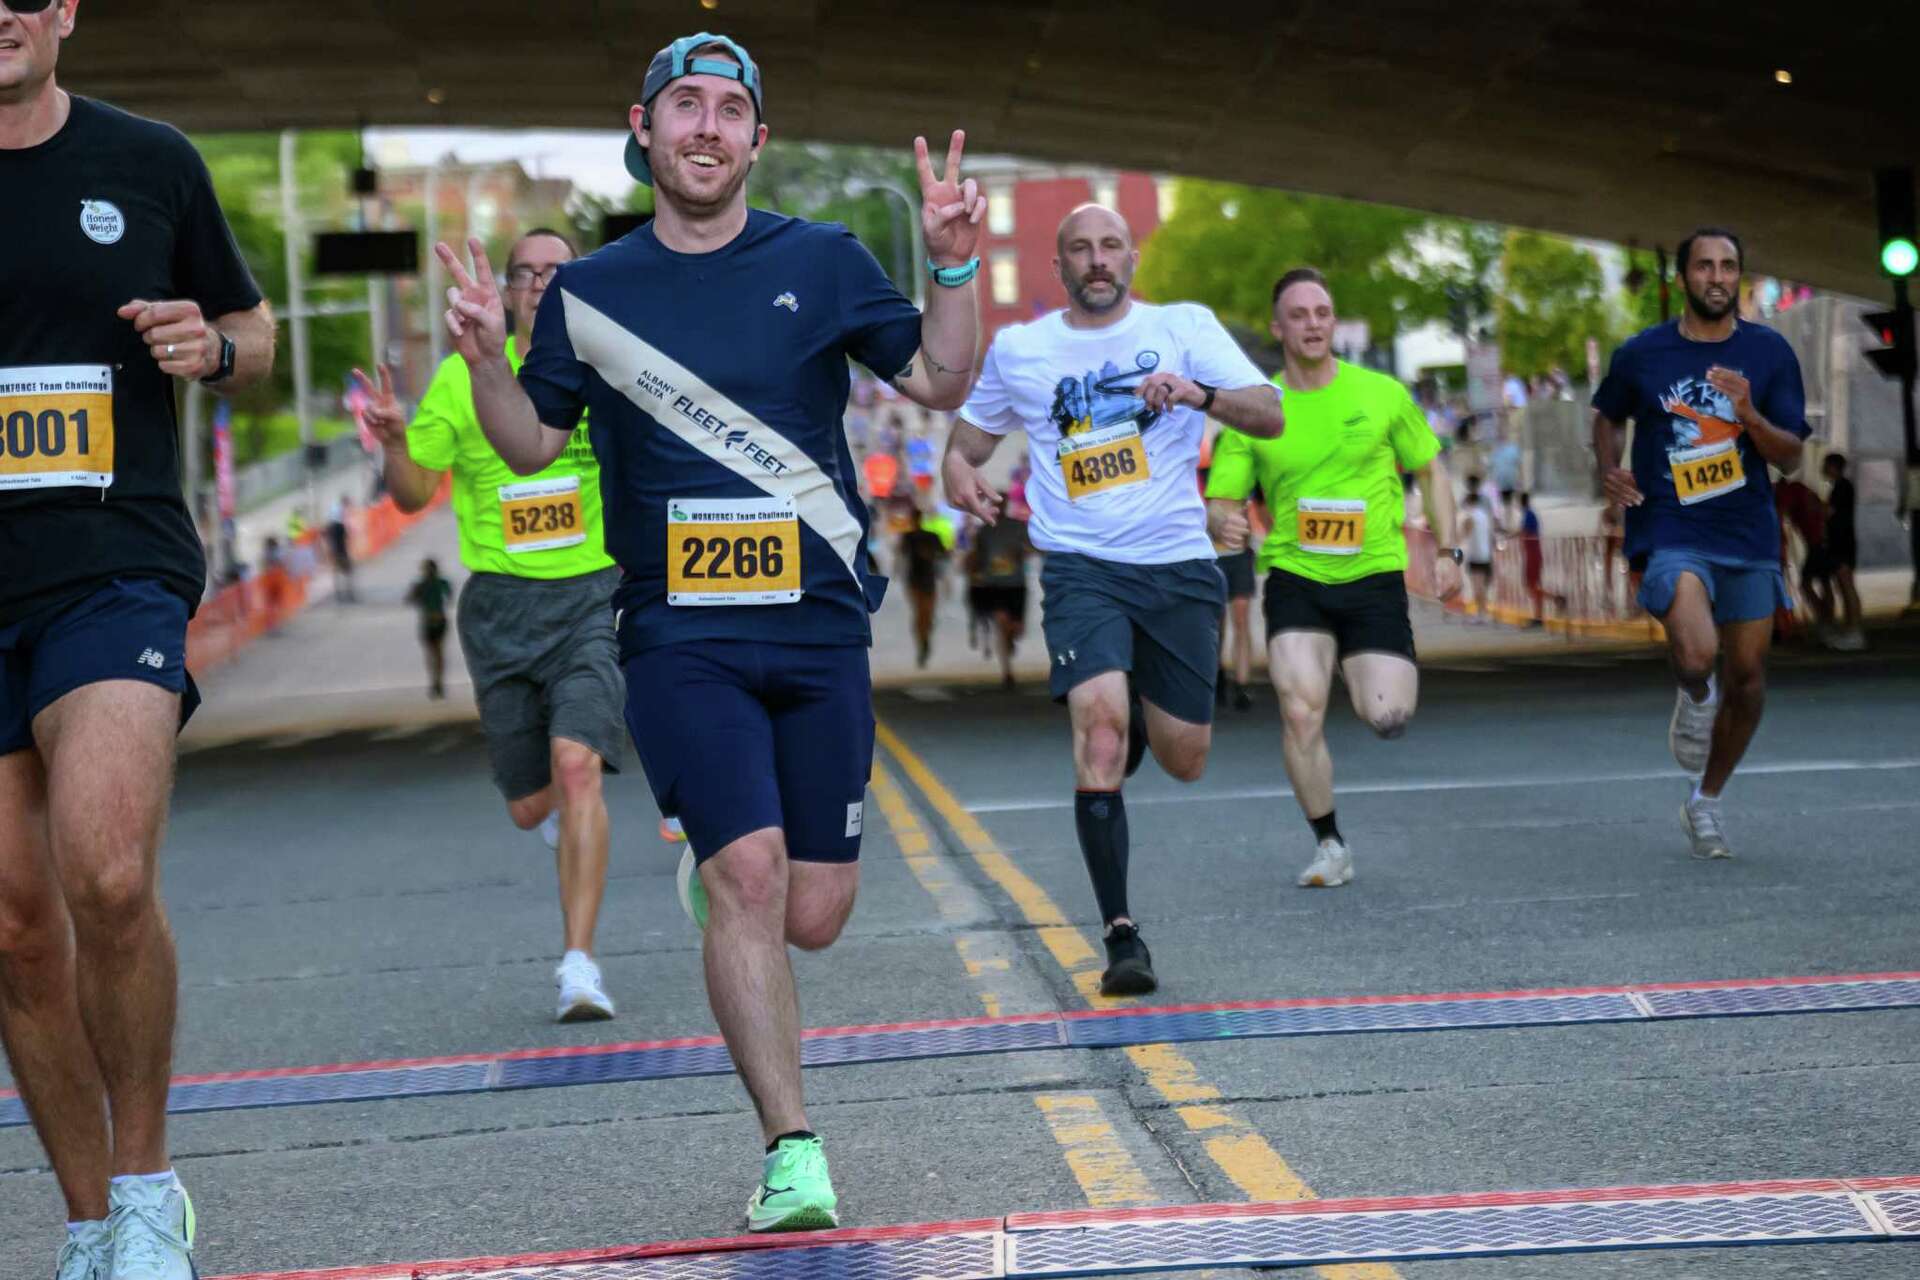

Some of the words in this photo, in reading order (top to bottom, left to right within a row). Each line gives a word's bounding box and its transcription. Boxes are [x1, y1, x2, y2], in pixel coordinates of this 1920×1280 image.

[86, 214, 118, 223] Honest
[88, 224, 119, 234] Weight
[40, 382, 62, 391] Team
[64, 381, 108, 391] Challenge
[636, 378, 664, 400] MALTA
[640, 370, 677, 395] ALBANY
[0, 409, 89, 459] 001
[672, 395, 729, 434] FLEET
[743, 442, 788, 475] FEET
[1071, 447, 1137, 487] 4386
[1683, 460, 1734, 491] 1426
[510, 502, 575, 536] 5238
[1305, 518, 1356, 542] 3771
[682, 535, 784, 579] 2266
